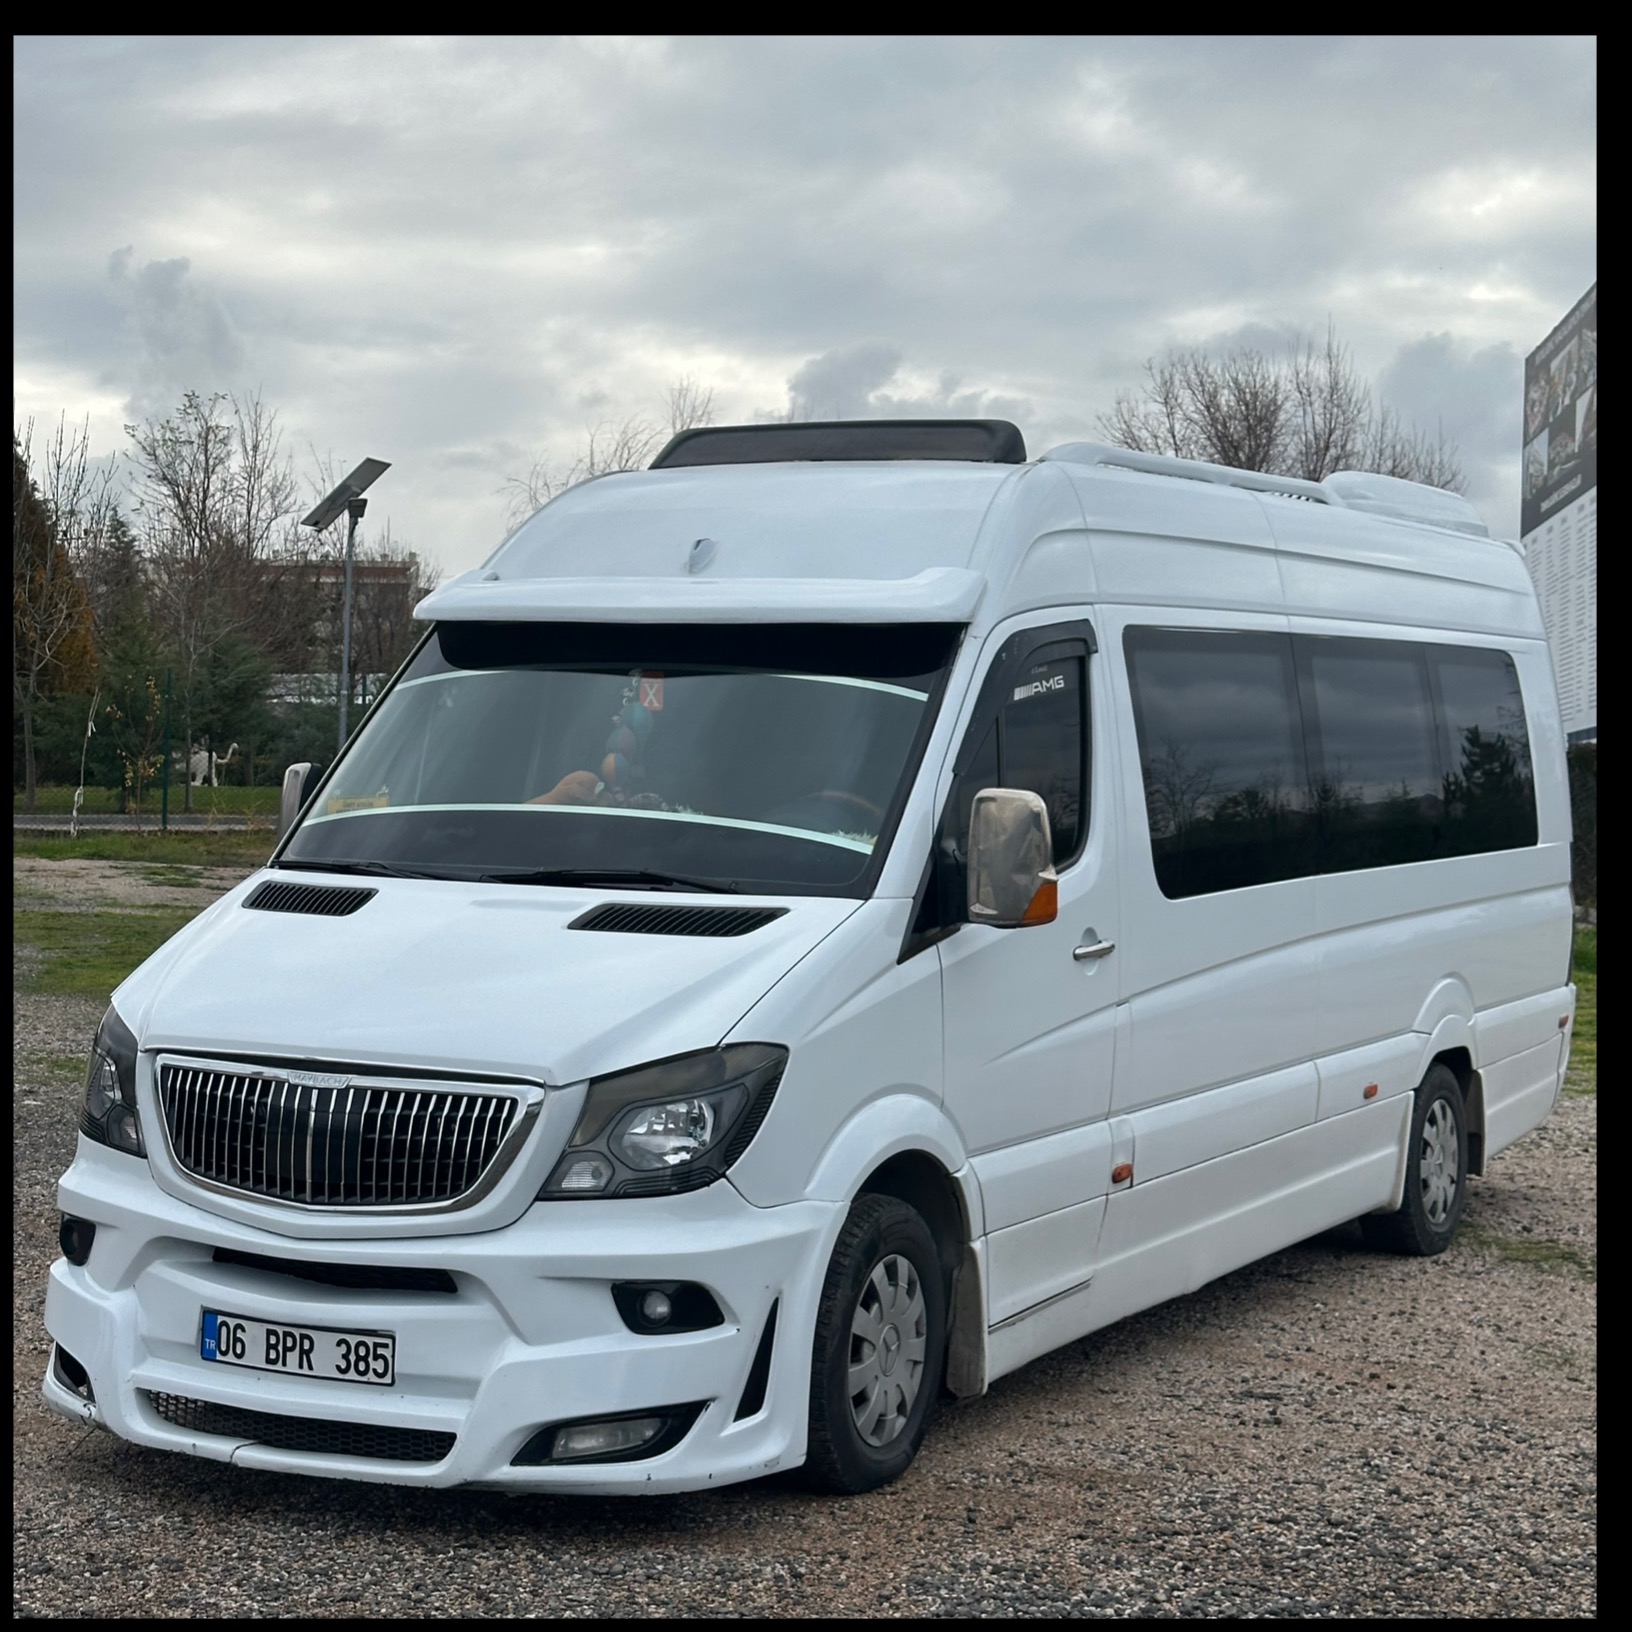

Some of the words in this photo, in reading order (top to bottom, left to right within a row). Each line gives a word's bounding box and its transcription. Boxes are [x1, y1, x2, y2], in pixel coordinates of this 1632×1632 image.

[293, 1073, 344, 1085] MAYBACH
[205, 1338, 216, 1351] TR
[217, 1320, 247, 1360] 06
[265, 1328, 315, 1372] BPR
[335, 1338, 390, 1380] 385
